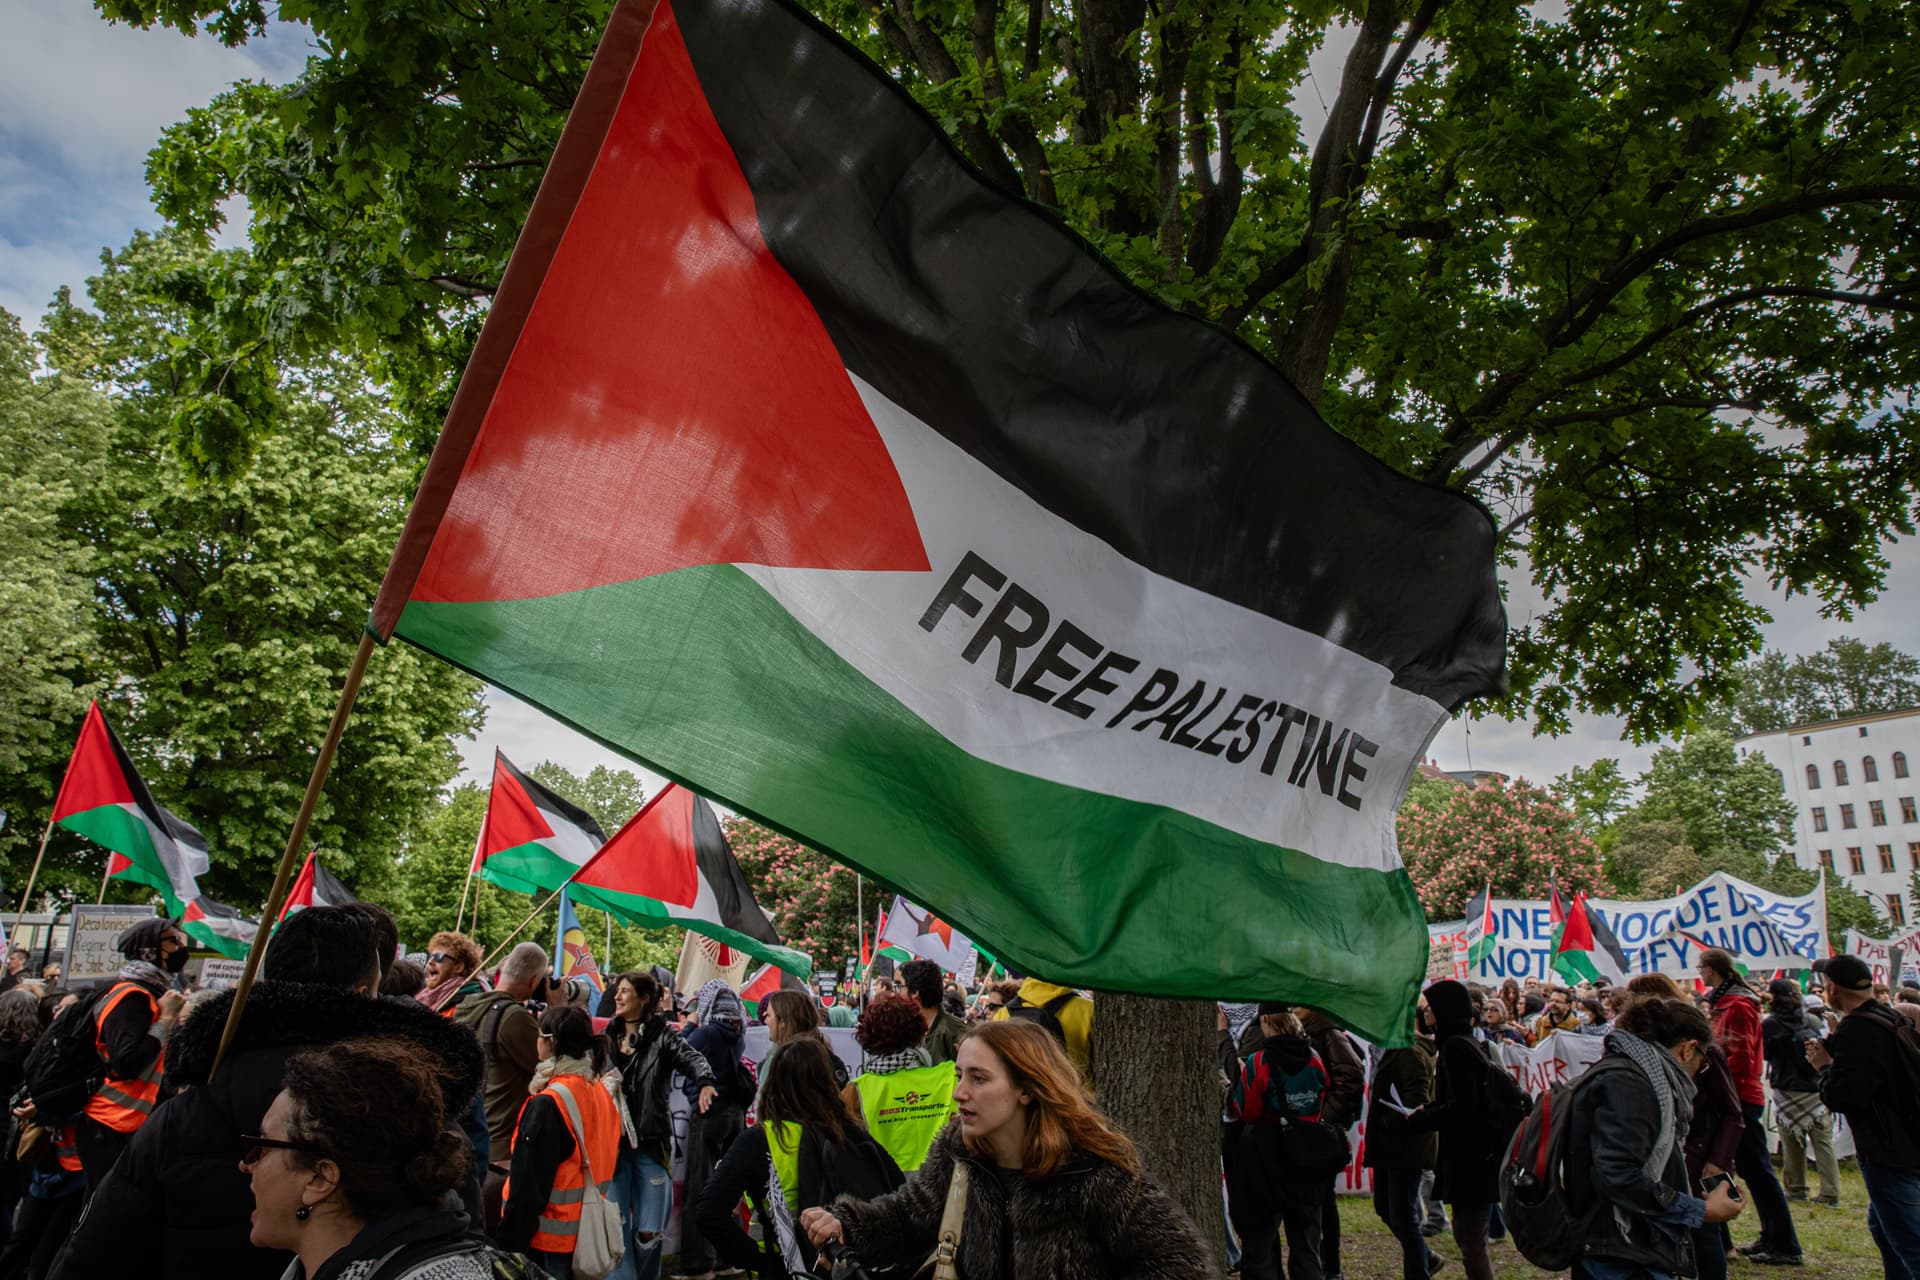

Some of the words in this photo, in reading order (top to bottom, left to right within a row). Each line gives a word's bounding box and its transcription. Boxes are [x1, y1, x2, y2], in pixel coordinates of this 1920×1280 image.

[918, 550, 1140, 720] FREE
[1106, 667, 1379, 811] PALESTINE
[1481, 946, 1551, 980] NOT
